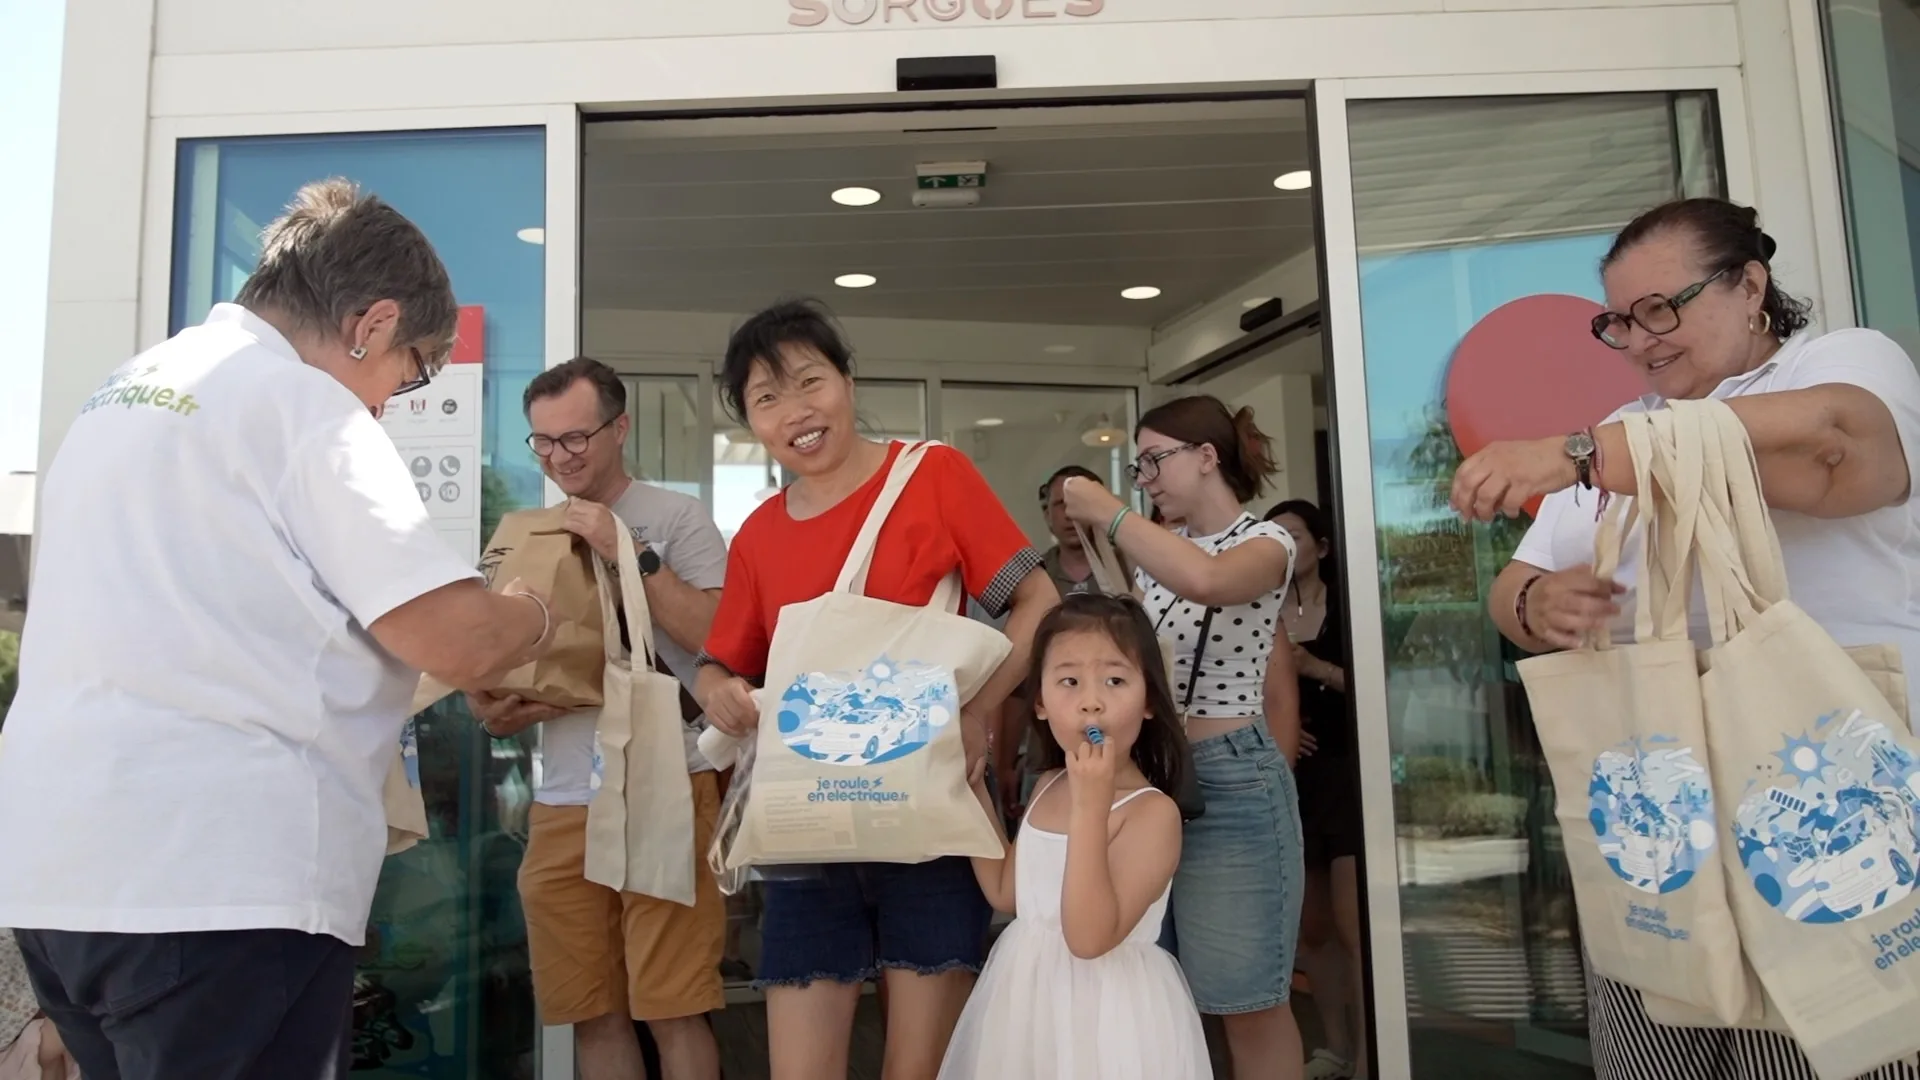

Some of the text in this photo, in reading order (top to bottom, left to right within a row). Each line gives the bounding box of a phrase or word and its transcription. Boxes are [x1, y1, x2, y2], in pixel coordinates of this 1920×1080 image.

[817, 776, 869, 791] je roule
[807, 791, 825, 802] en
[1870, 933, 1893, 953] je
[1875, 951, 1899, 970] en
